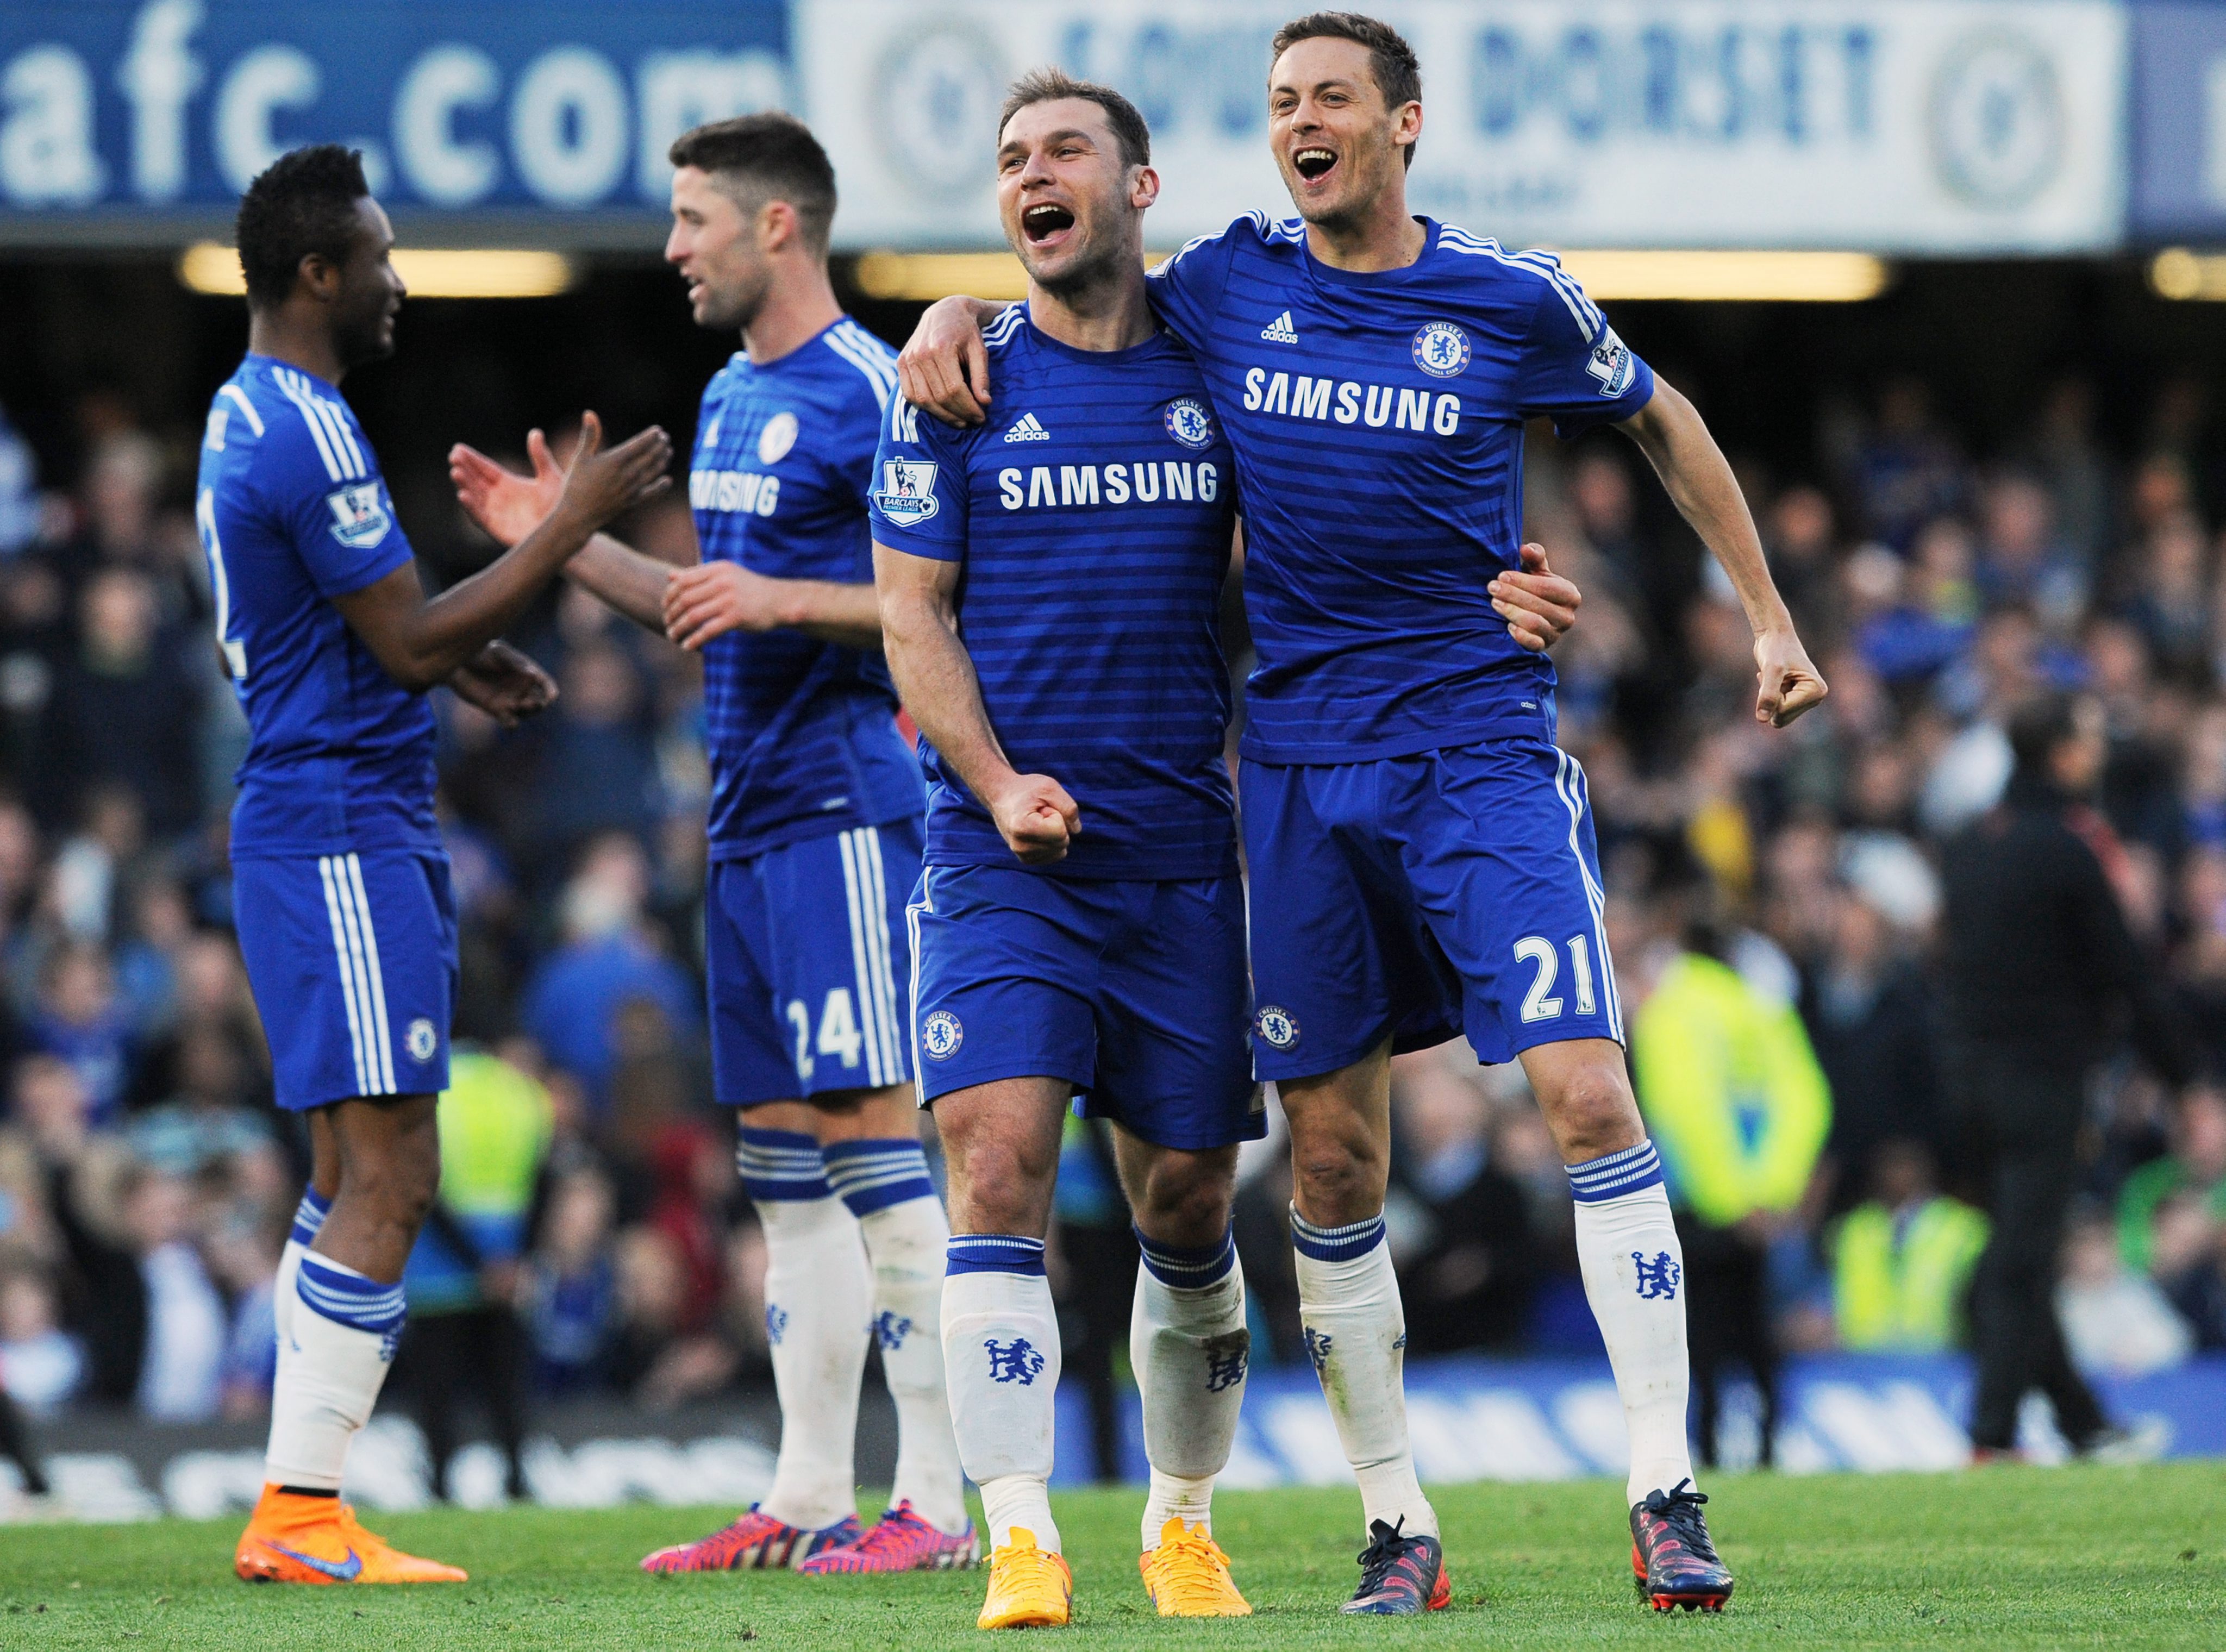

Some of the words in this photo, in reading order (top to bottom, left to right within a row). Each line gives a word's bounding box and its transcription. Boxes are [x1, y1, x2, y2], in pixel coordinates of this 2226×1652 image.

[1261, 328, 1298, 345] adidas
[1425, 323, 1463, 339] CHELSEA
[1171, 399, 1203, 414] CHELSEA
[1243, 367, 1461, 436] SAMSUNG
[1004, 430, 1050, 443] adidas
[998, 461, 1217, 510] SAMSUNG
[884, 497, 920, 508] BARCLAYS
[1514, 934, 1597, 1024] 21
[925, 1012, 951, 1028] CHELSEA
[1258, 1008, 1286, 1018] CHELSEA
